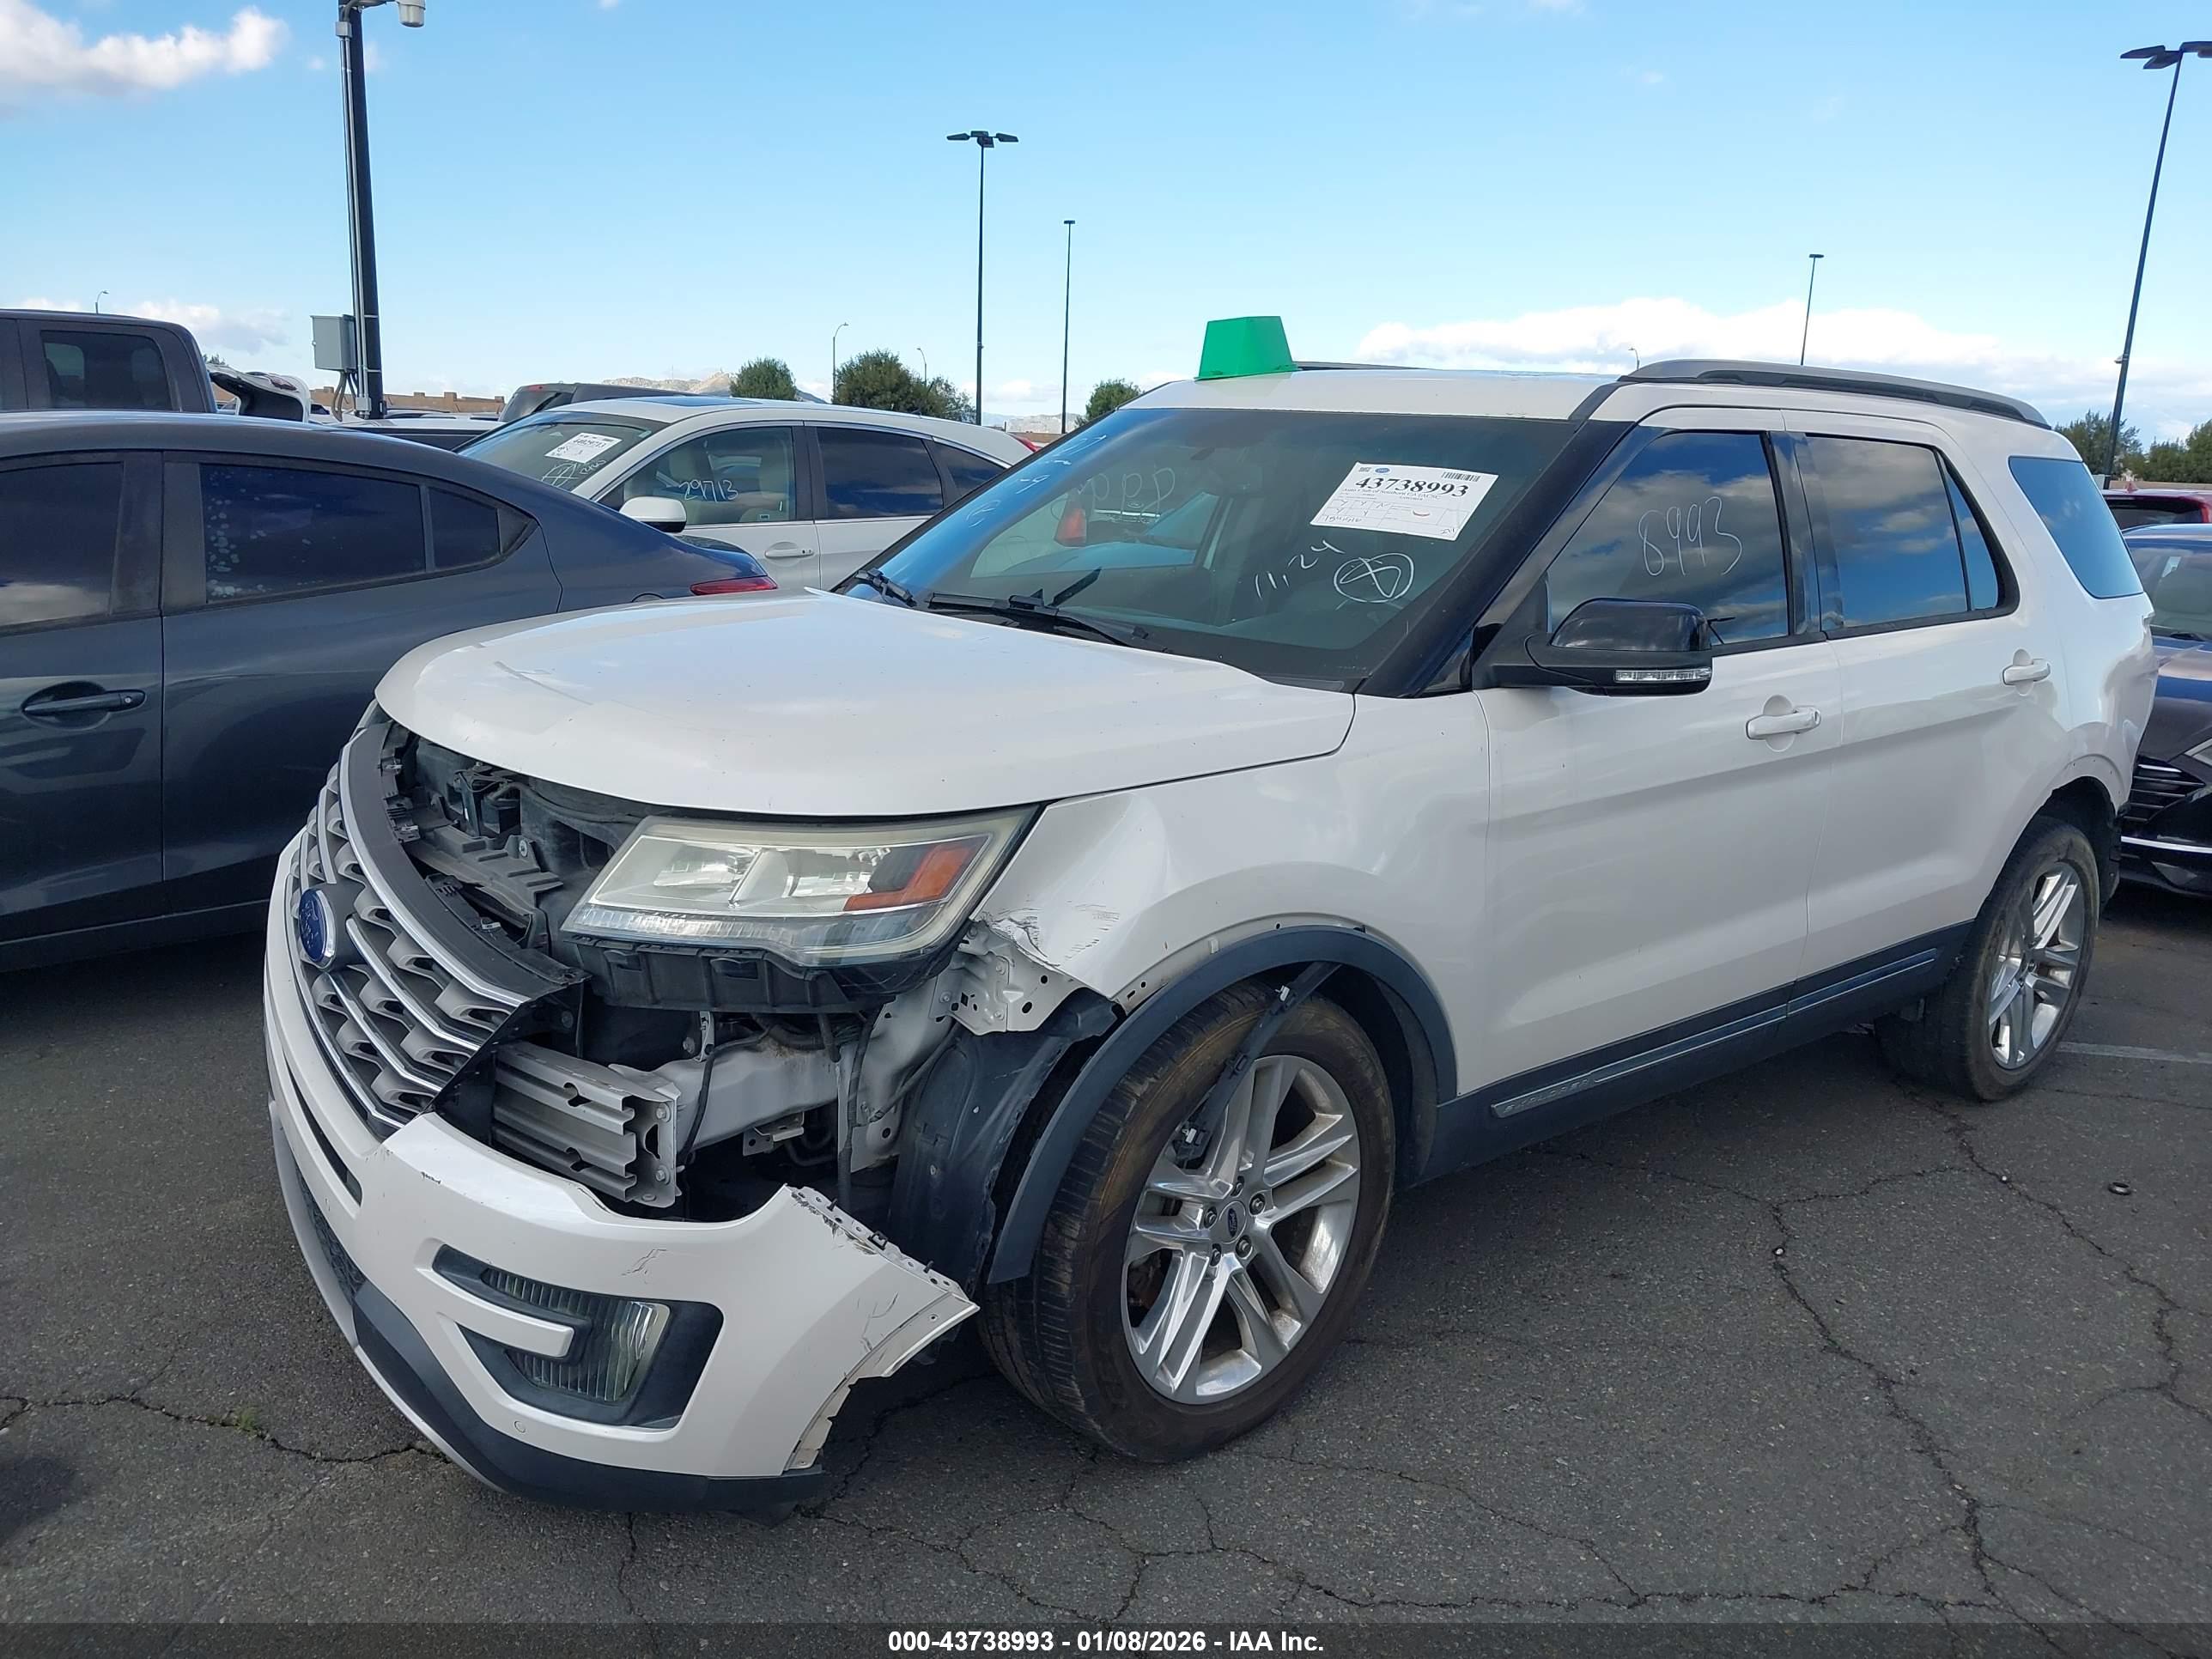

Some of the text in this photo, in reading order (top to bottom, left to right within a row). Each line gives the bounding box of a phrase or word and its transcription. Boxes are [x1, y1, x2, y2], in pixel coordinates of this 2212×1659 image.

[678, 478, 738, 503] 29713
[1355, 477, 1469, 498] 43738993
[1638, 495, 1743, 576] 8993
